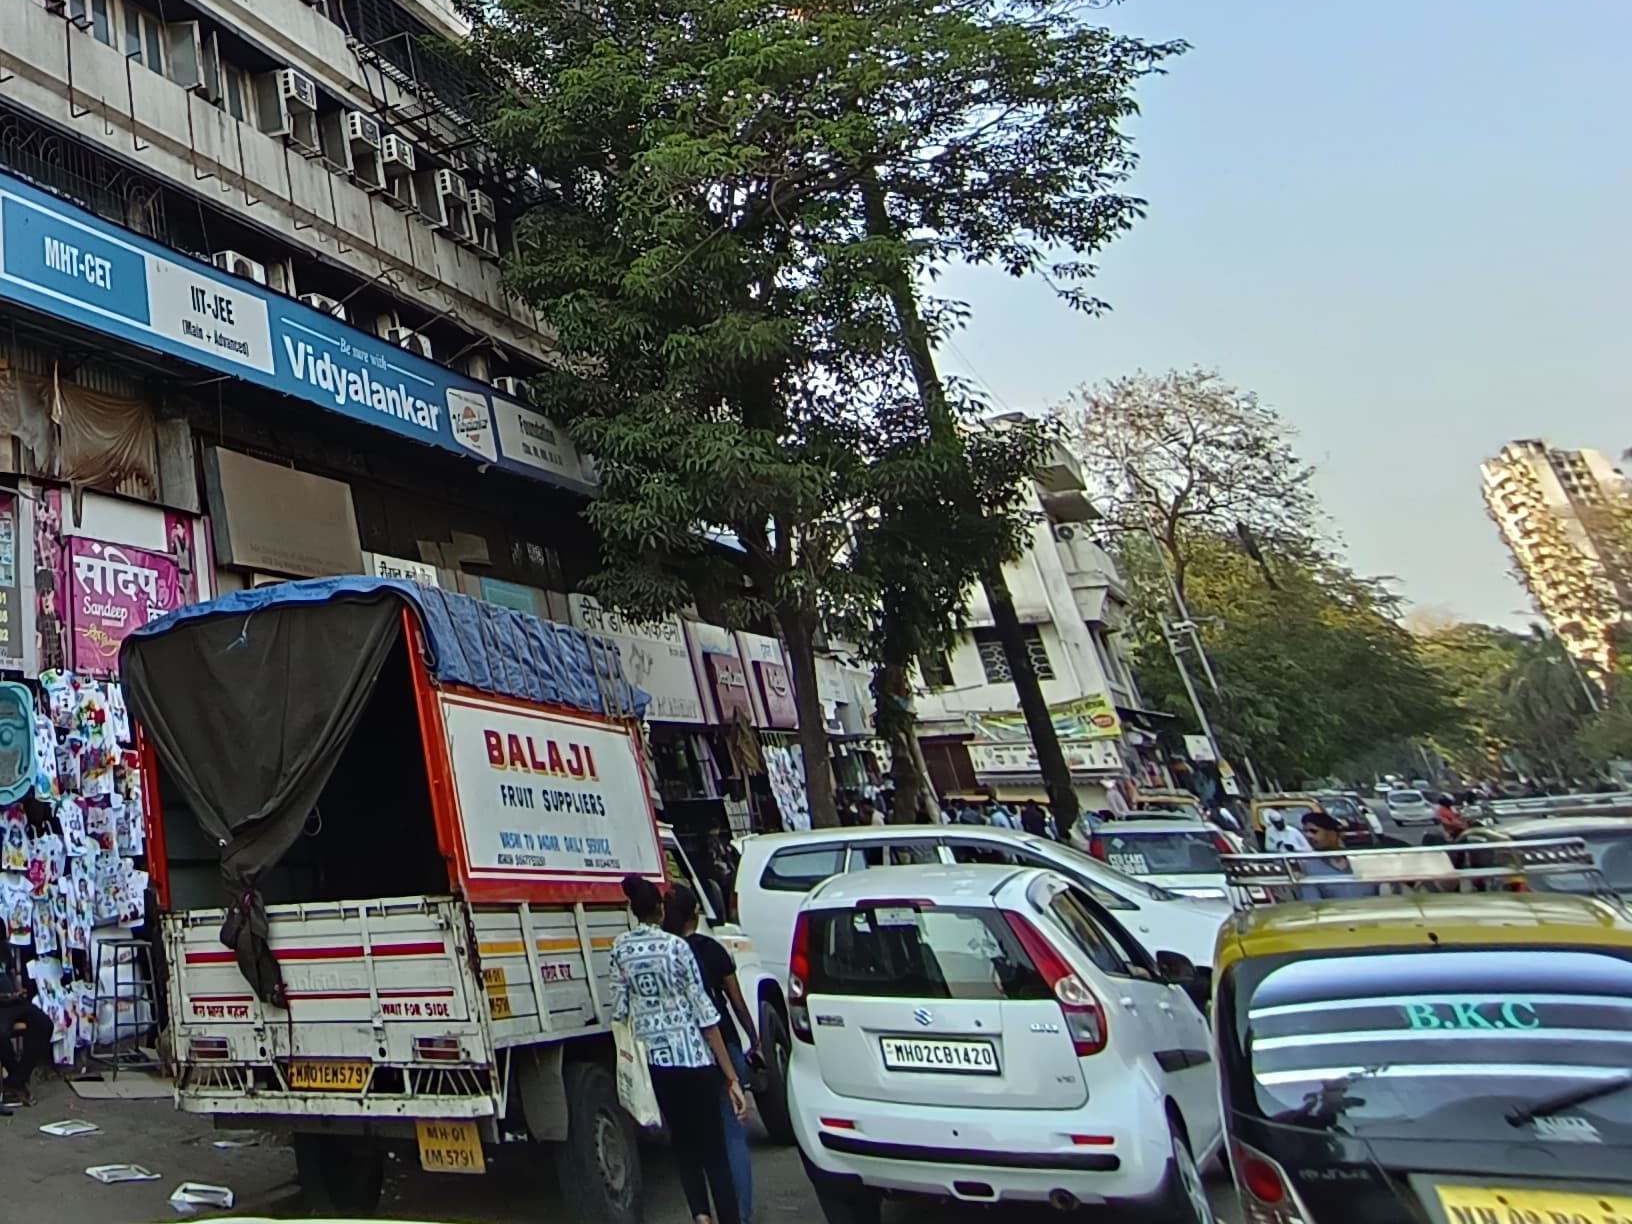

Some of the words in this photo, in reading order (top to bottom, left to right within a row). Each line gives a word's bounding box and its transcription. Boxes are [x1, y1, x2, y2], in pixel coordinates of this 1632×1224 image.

[43, 235, 112, 291] MHT-CET
[190, 285, 235, 326] IIT-JEE
[281, 332, 442, 433] Vidyalankar
[82, 596, 128, 620] Sandeep
[483, 729, 600, 782] BALAJI
[500, 784, 534, 809] FRUIT
[542, 789, 606, 816] SUPPLIERS
[381, 1002, 401, 1016] WAIT
[404, 1002, 420, 1016] FOR
[425, 1002, 450, 1017] SIDE
[1404, 1002, 1540, 1031] B.K.C
[893, 1038, 993, 1066] MH02CB1420
